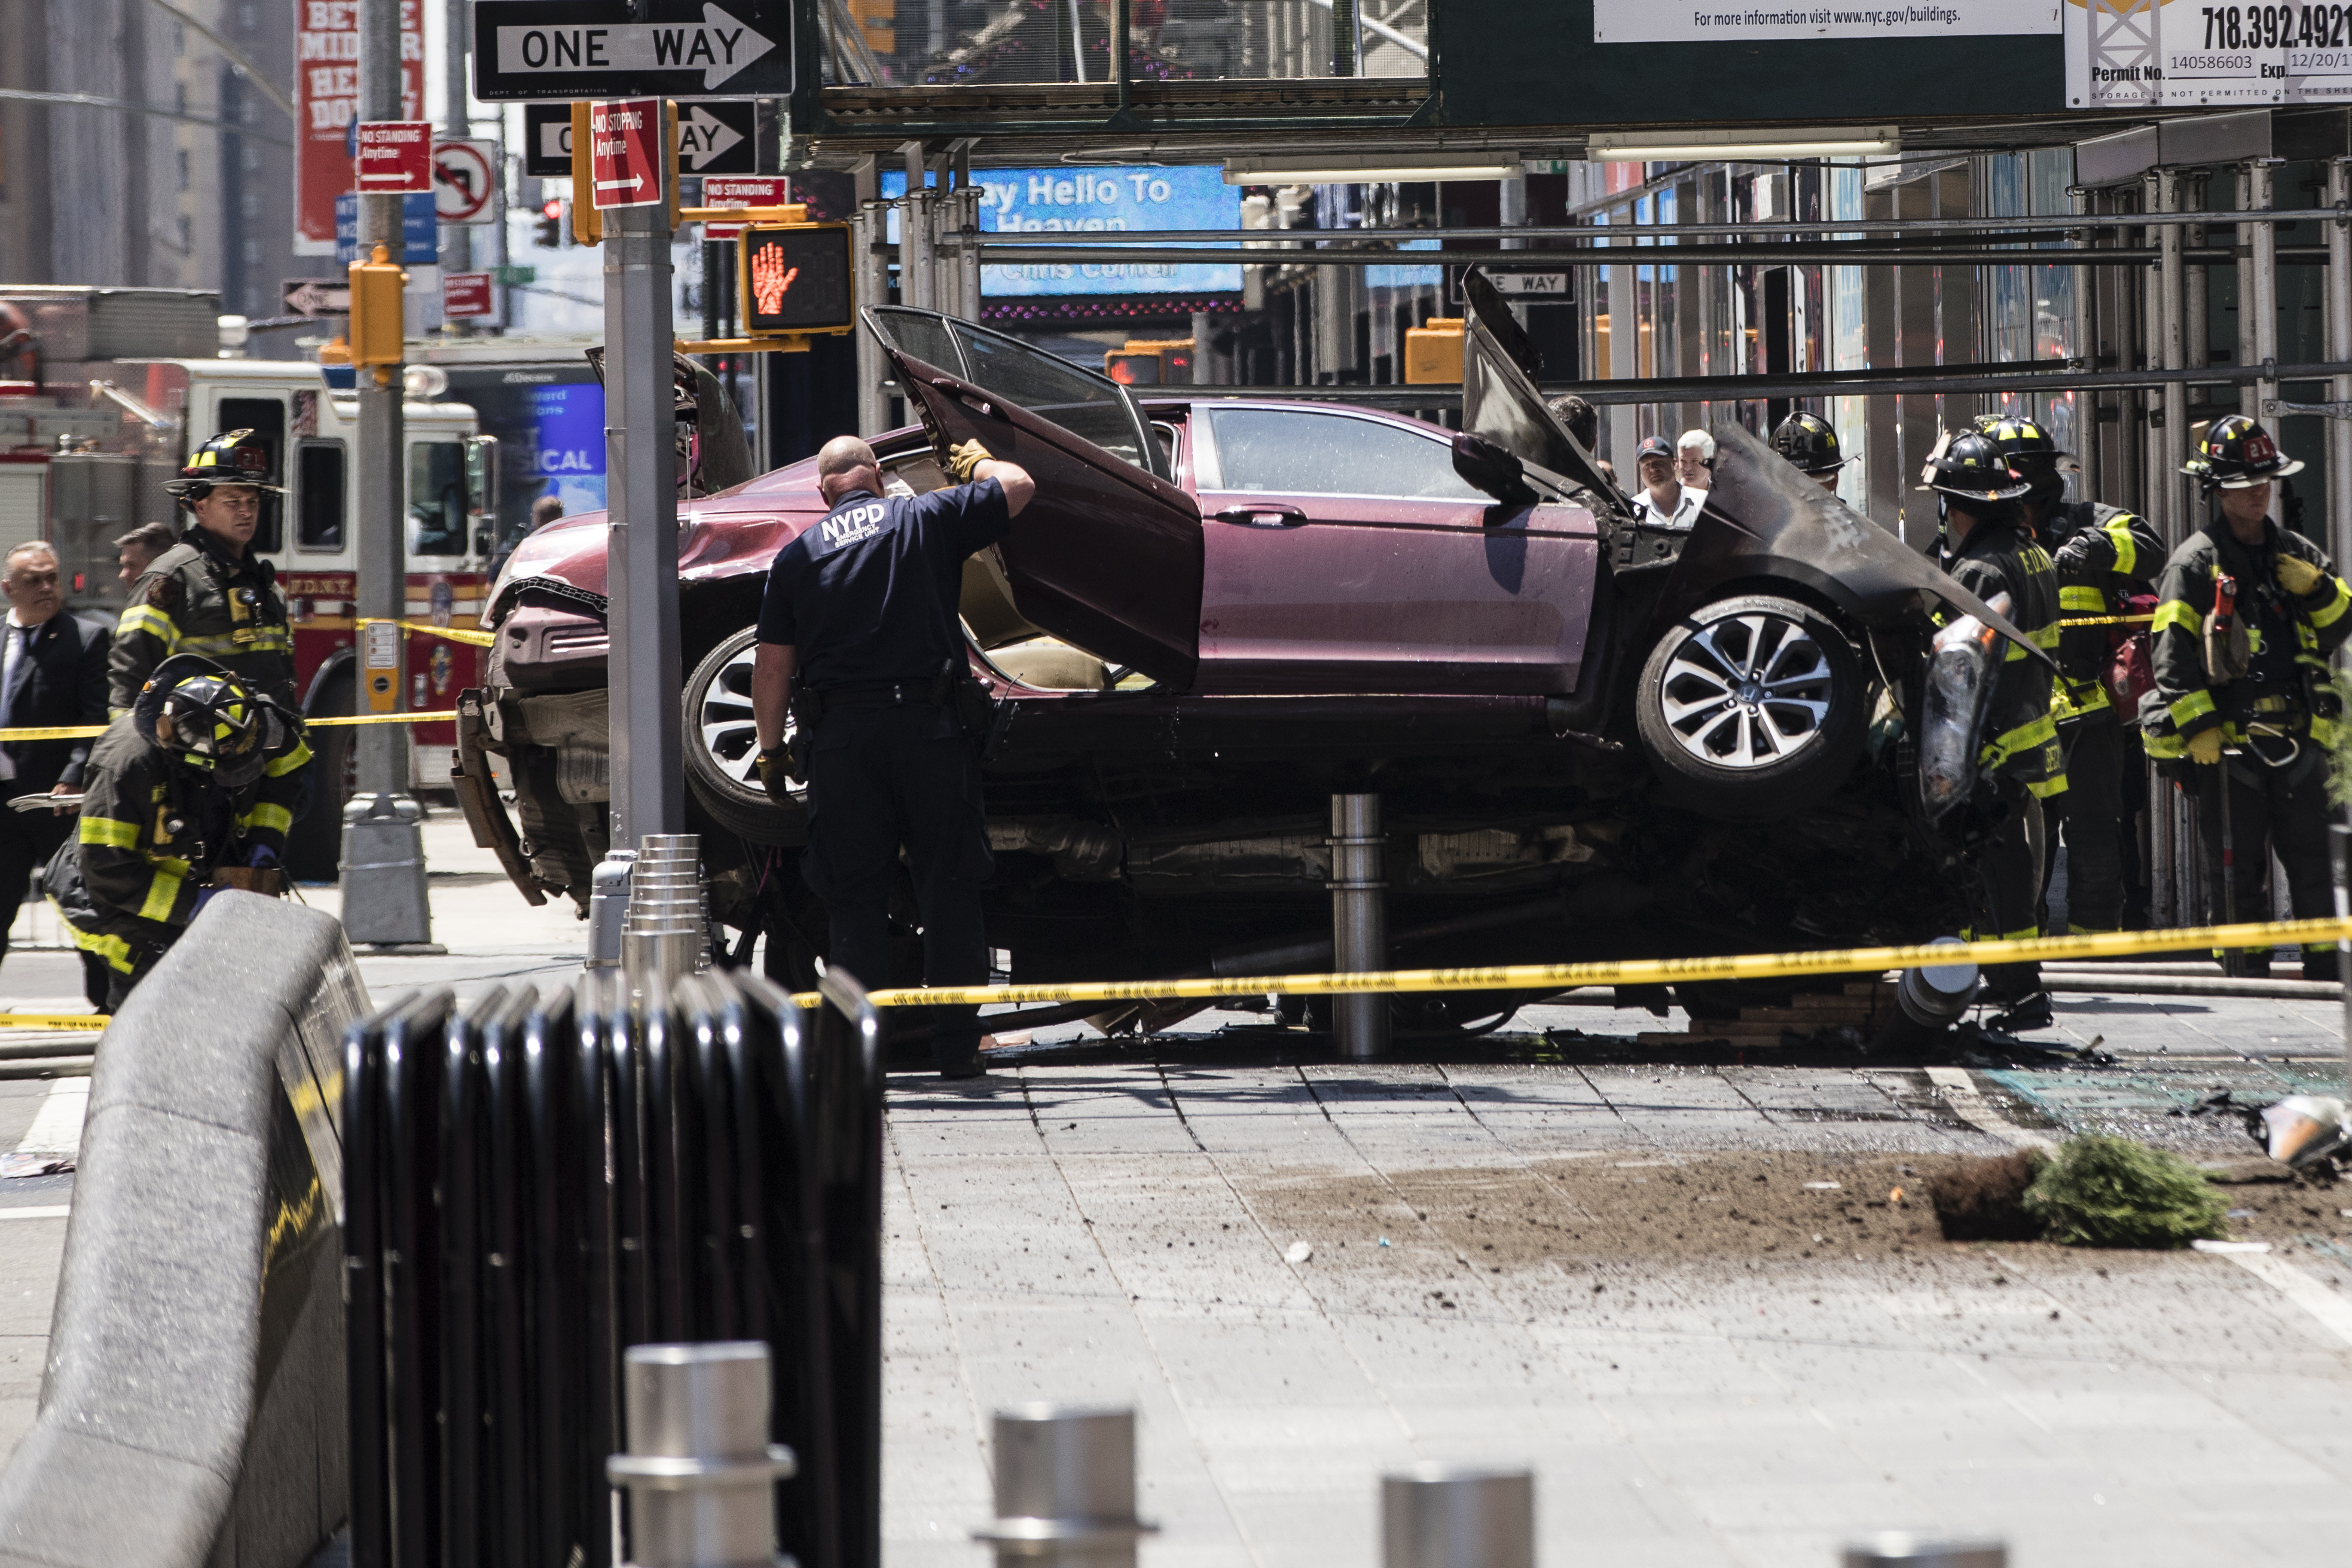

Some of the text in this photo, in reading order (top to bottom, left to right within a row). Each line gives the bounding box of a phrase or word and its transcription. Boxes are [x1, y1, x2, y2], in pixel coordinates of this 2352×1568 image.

[307, 1, 415, 29] BEE
[1694, 5, 1961, 26] For more information visit www.nyc.gov/buildings.
[299, 32, 420, 60] MIDR
[522, 27, 744, 68] ONE WAY
[2092, 52, 2352, 82] Permit No. 140586603 Exp. 12/20/1
[595, 111, 643, 133] NO STOPPING
[361, 131, 374, 143] NO
[375, 130, 420, 143] STANDING
[679, 125, 720, 152] AY
[362, 147, 399, 161] Anytime
[596, 137, 627, 161] Anytime
[707, 184, 772, 196] NO STANDING
[1027, 174, 1119, 206] Hello
[1125, 173, 1172, 204] To
[709, 198, 749, 208] Anytime
[1522, 276, 1559, 291] WAY
[1778, 436, 1808, 455] 54
[2249, 441, 2269, 459] 21
[243, 453, 260, 466] 21
[821, 503, 885, 541] NYPD
[836, 523, 875, 542] EMERGENCY
[835, 527, 879, 548] SERVICE UNIT
